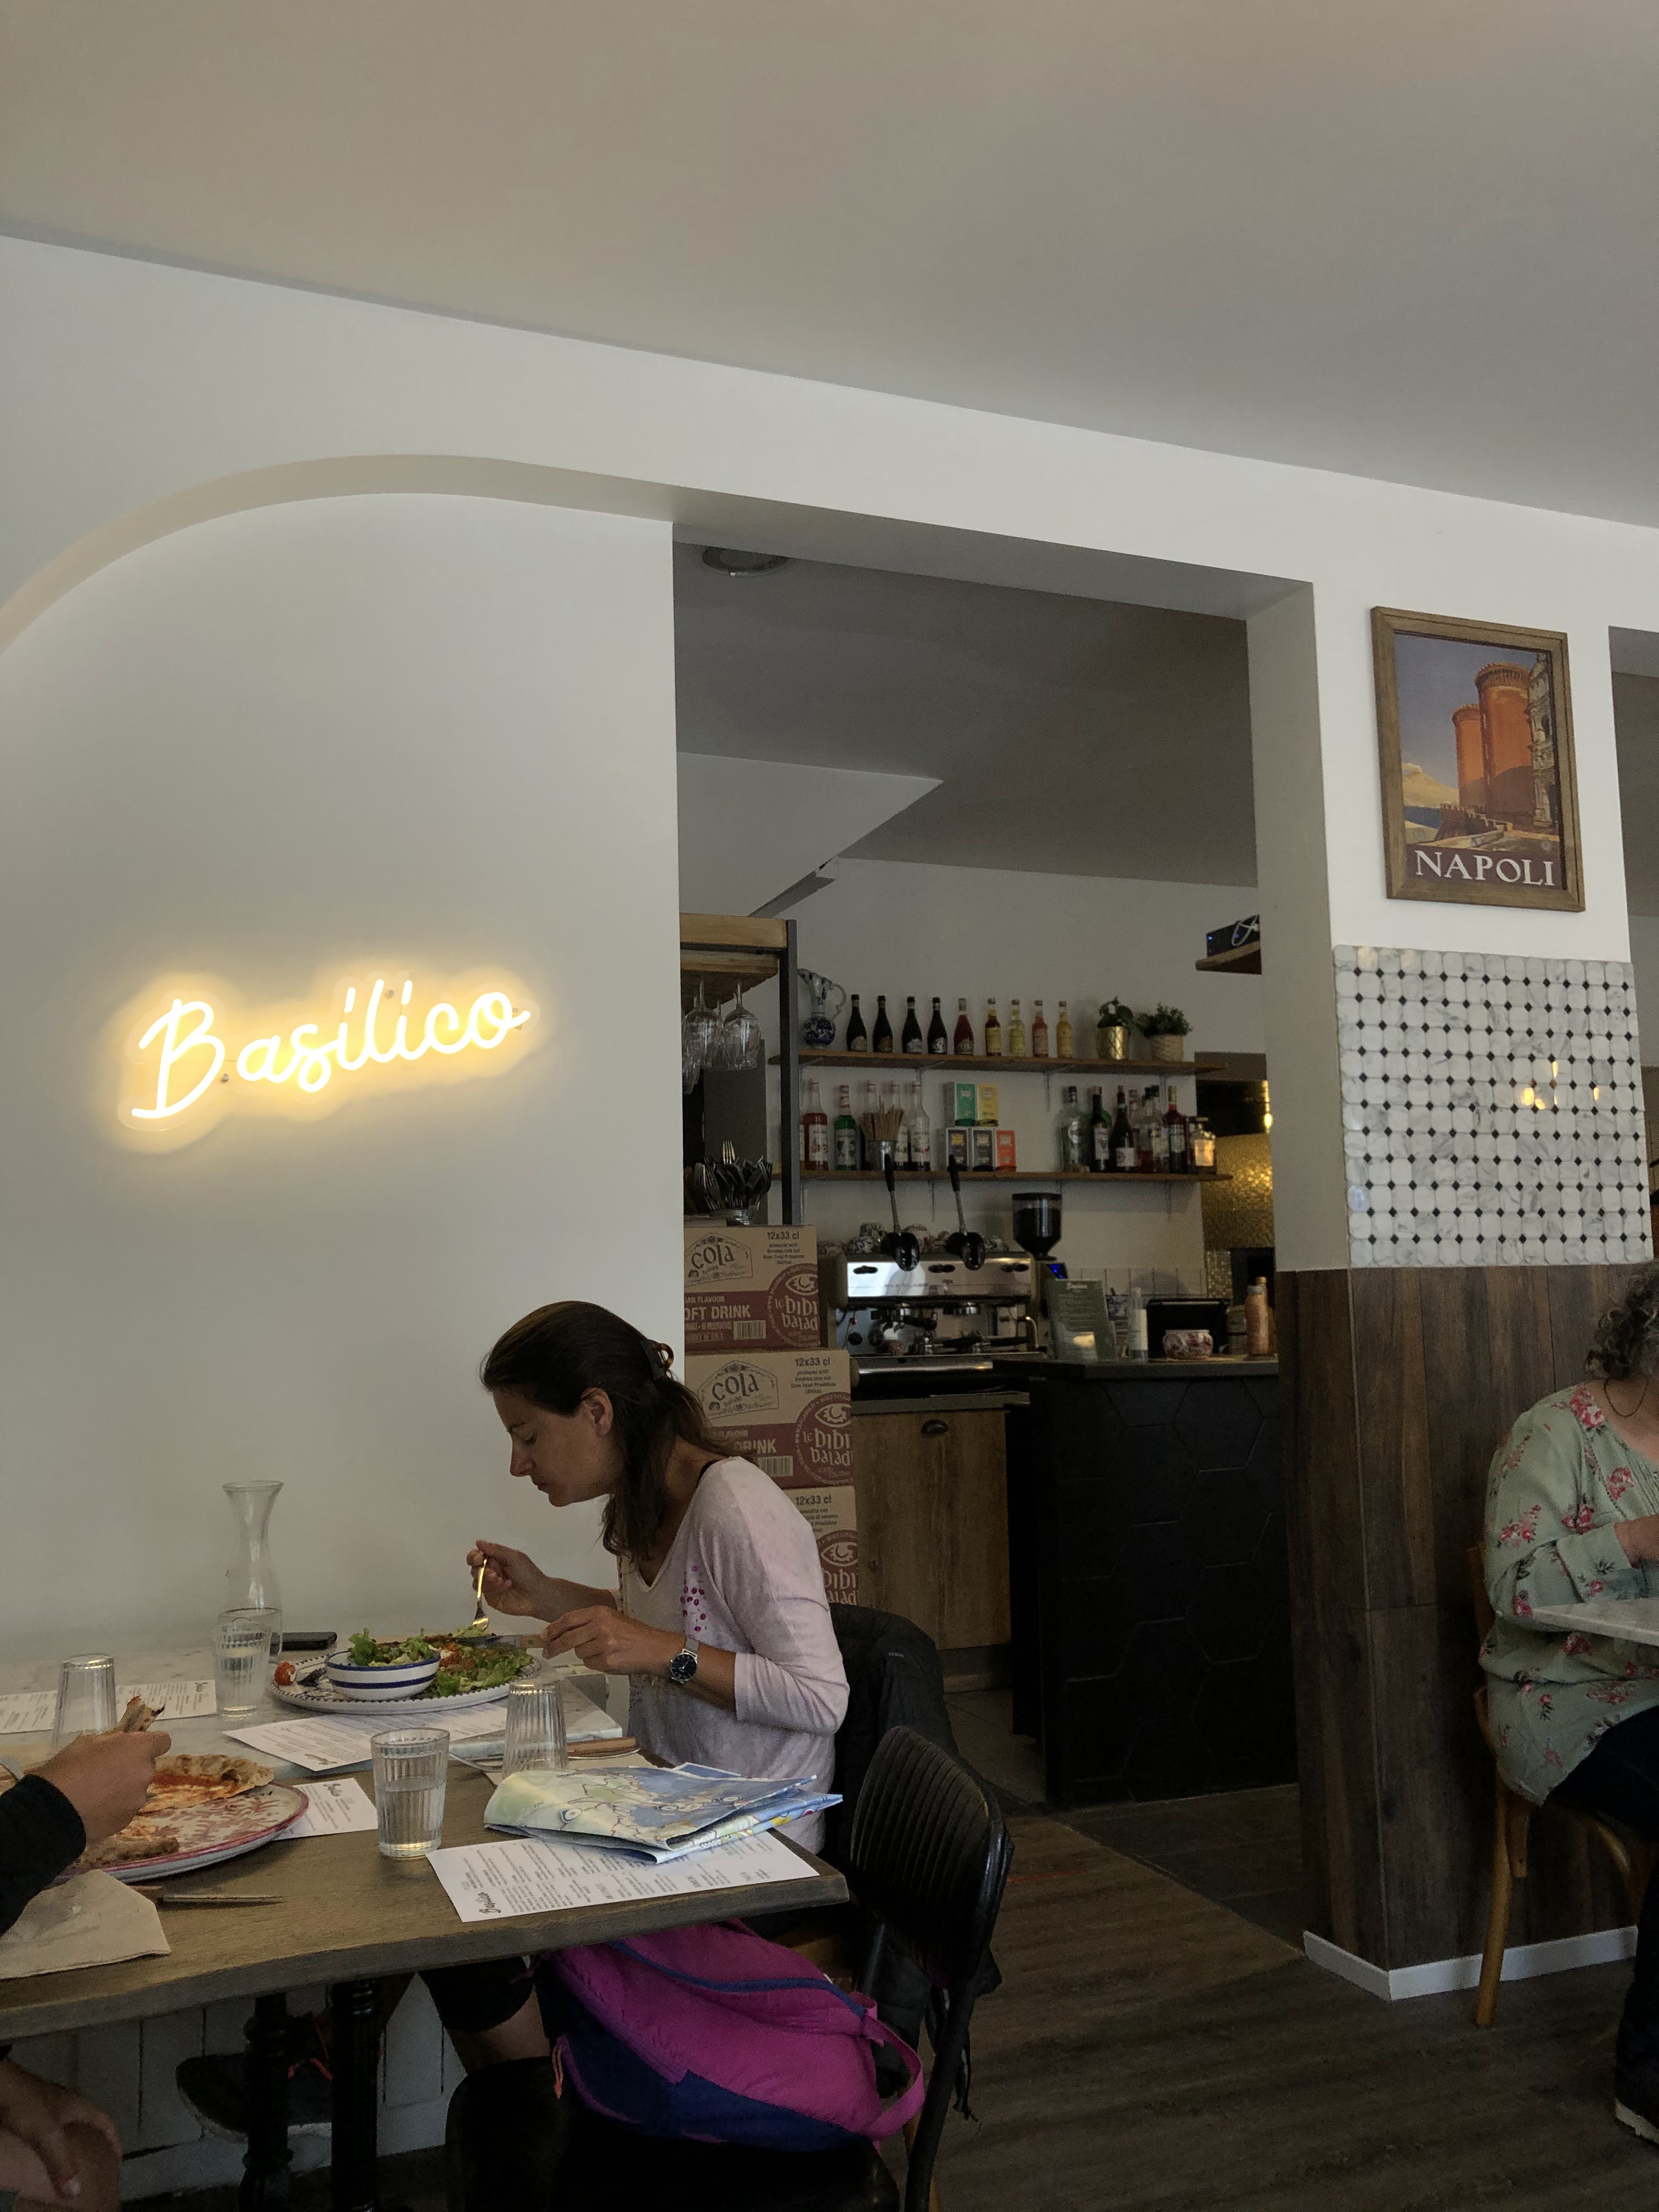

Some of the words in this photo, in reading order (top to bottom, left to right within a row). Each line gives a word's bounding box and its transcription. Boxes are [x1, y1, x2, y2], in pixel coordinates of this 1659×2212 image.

[1414, 850, 1555, 886] NAPOLI
[131, 979, 531, 1119] Basilico
[767, 1231, 790, 1240] 12x33
[792, 1231, 799, 1239] cl
[691, 1244, 735, 1269] cola
[685, 1307, 707, 1321] OFT
[711, 1304, 752, 1319] DRINK
[785, 1295, 818, 1316] bibi
[781, 1312, 819, 1331] balad
[795, 1357, 820, 1367] 12x33
[822, 1357, 830, 1366] cl
[712, 1372, 760, 1401] cola
[814, 1427, 850, 1450] bibi
[795, 1495, 821, 1505] 12x33
[823, 1494, 832, 1504] cl
